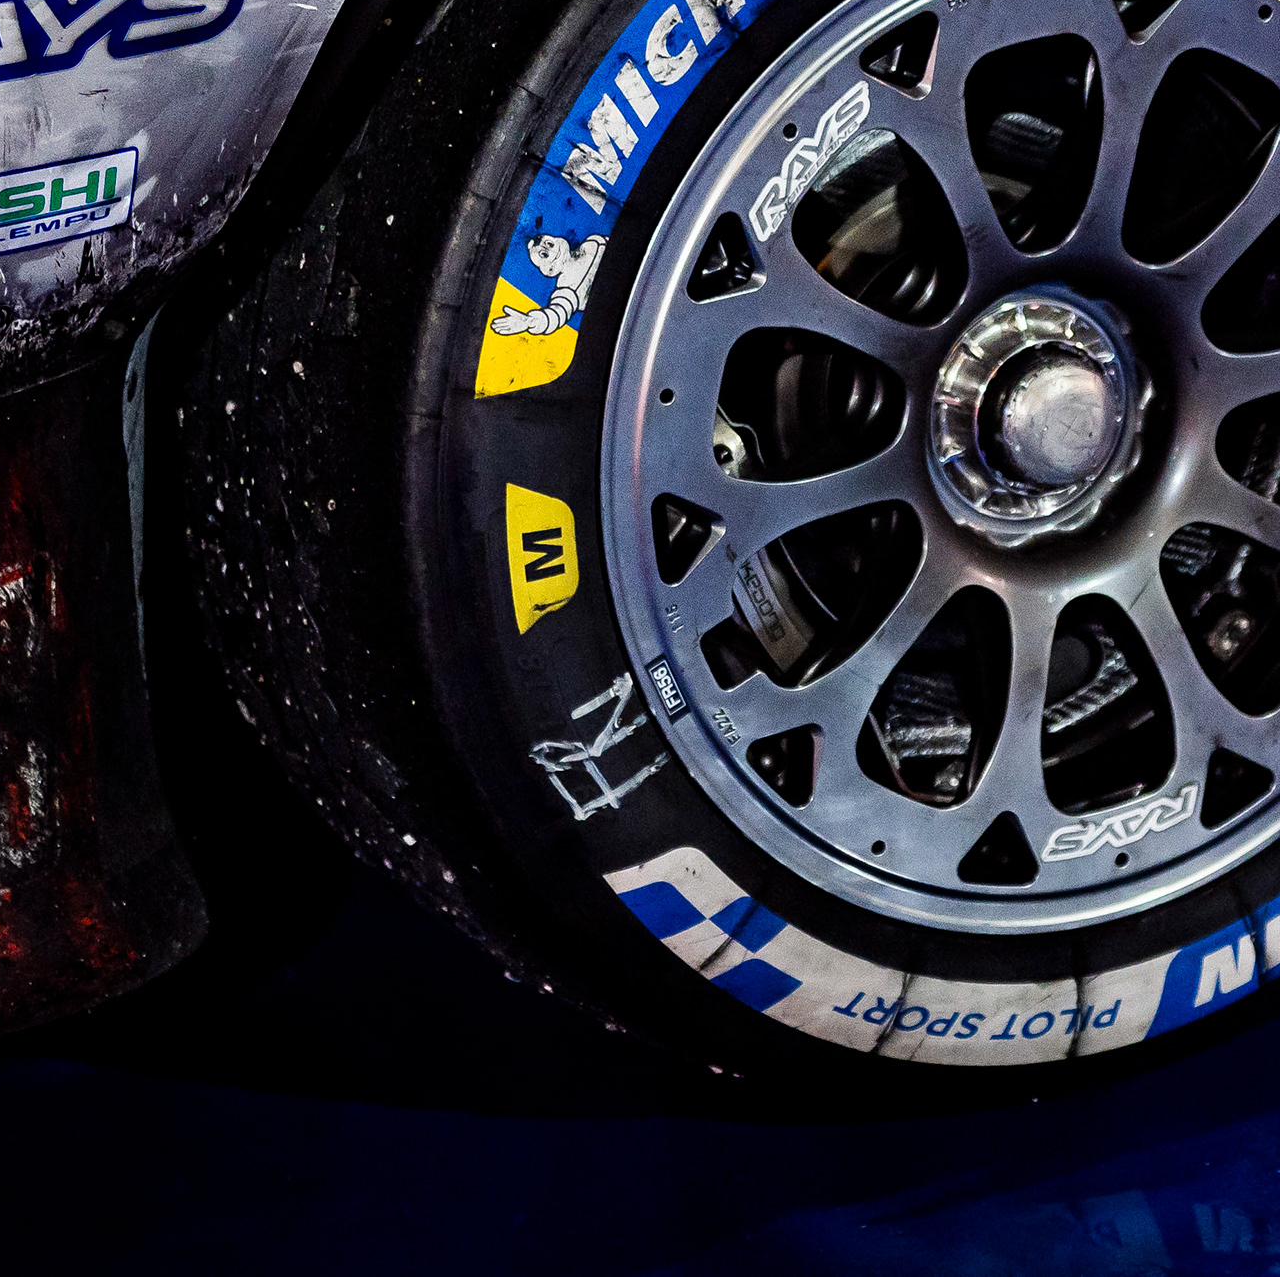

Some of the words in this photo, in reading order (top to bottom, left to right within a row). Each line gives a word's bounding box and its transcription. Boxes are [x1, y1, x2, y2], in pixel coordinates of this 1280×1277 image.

[748, 80, 871, 243] RAYS
[523, 526, 567, 583] M
[652, 665, 683, 711] FR56
[1041, 783, 1199, 863] RAYS
[831, 990, 987, 1040] SPORT
[988, 998, 1123, 1041] PILOT
